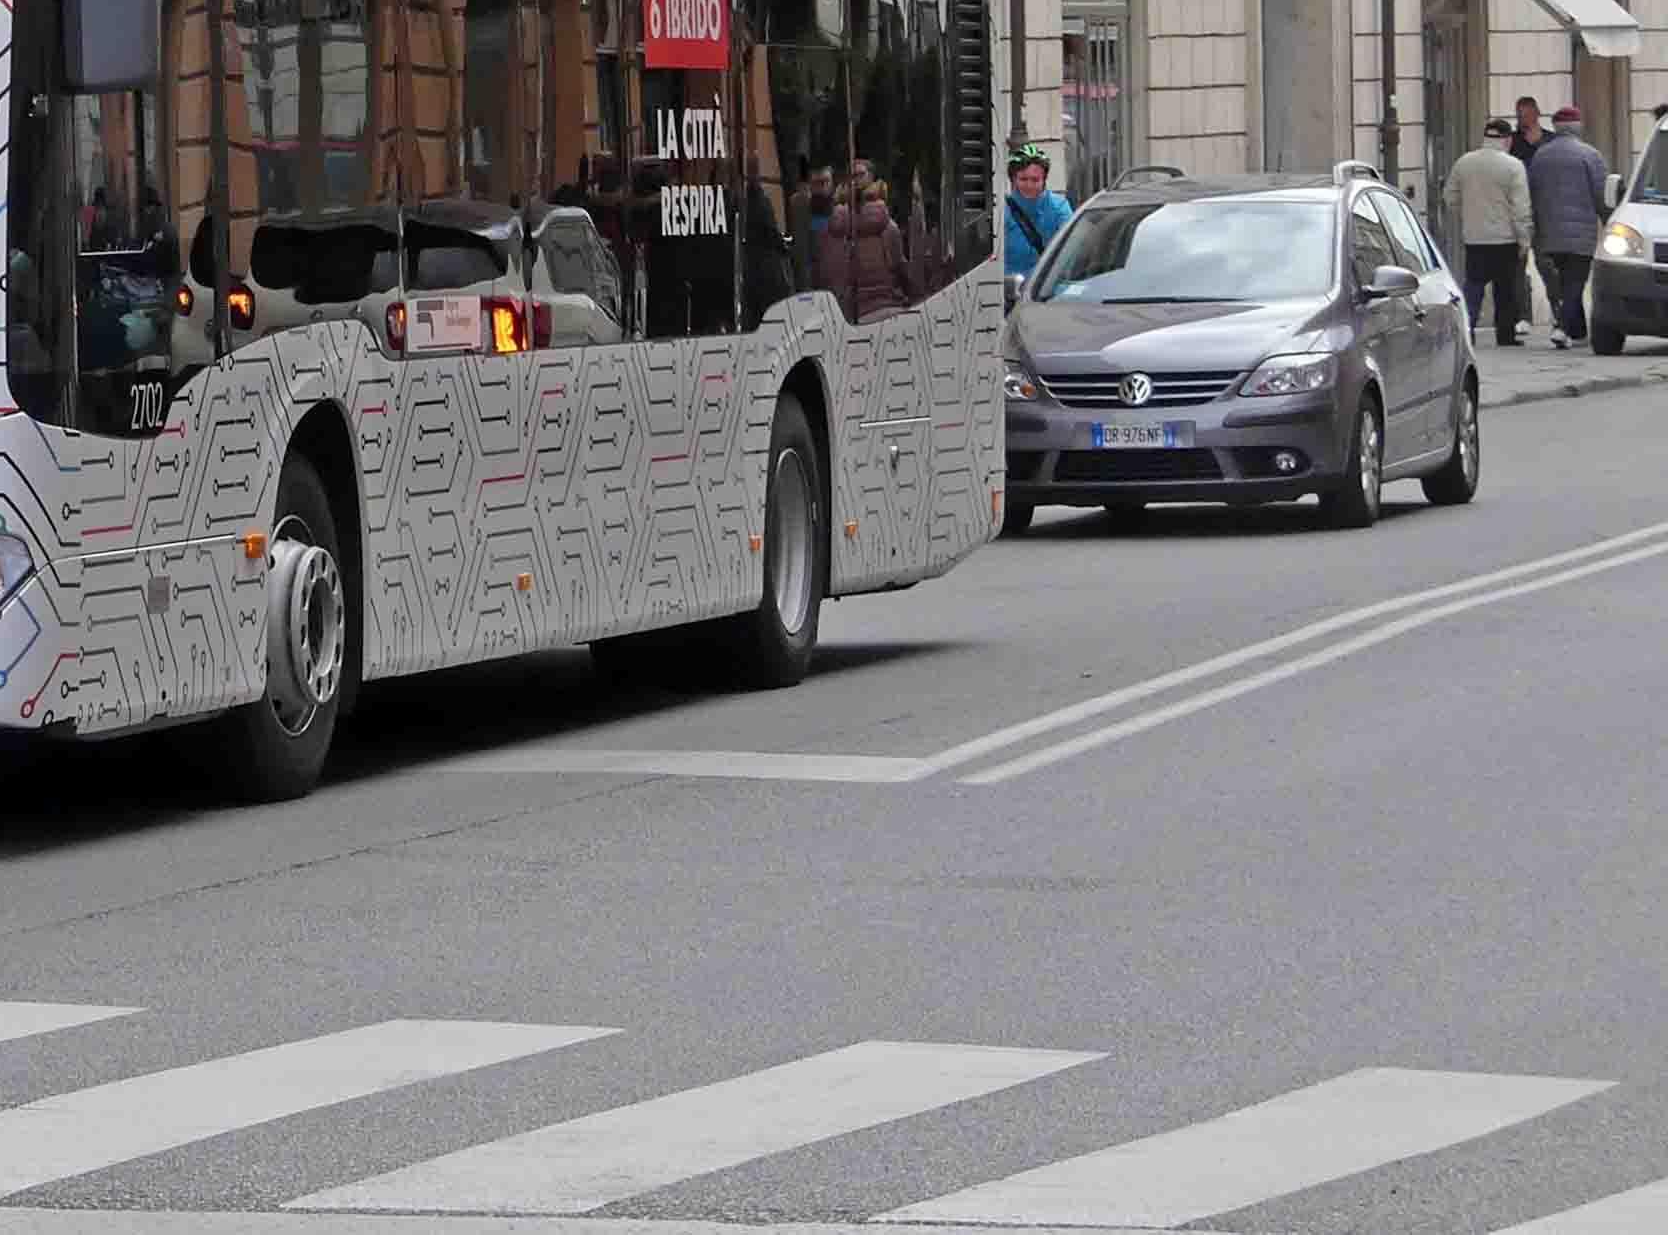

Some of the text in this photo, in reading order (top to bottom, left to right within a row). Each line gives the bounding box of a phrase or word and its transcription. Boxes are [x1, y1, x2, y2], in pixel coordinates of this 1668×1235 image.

[657, 93, 726, 160] LA CITTÀ
[660, 184, 728, 236] RESPIRA
[130, 381, 164, 430] 2702
